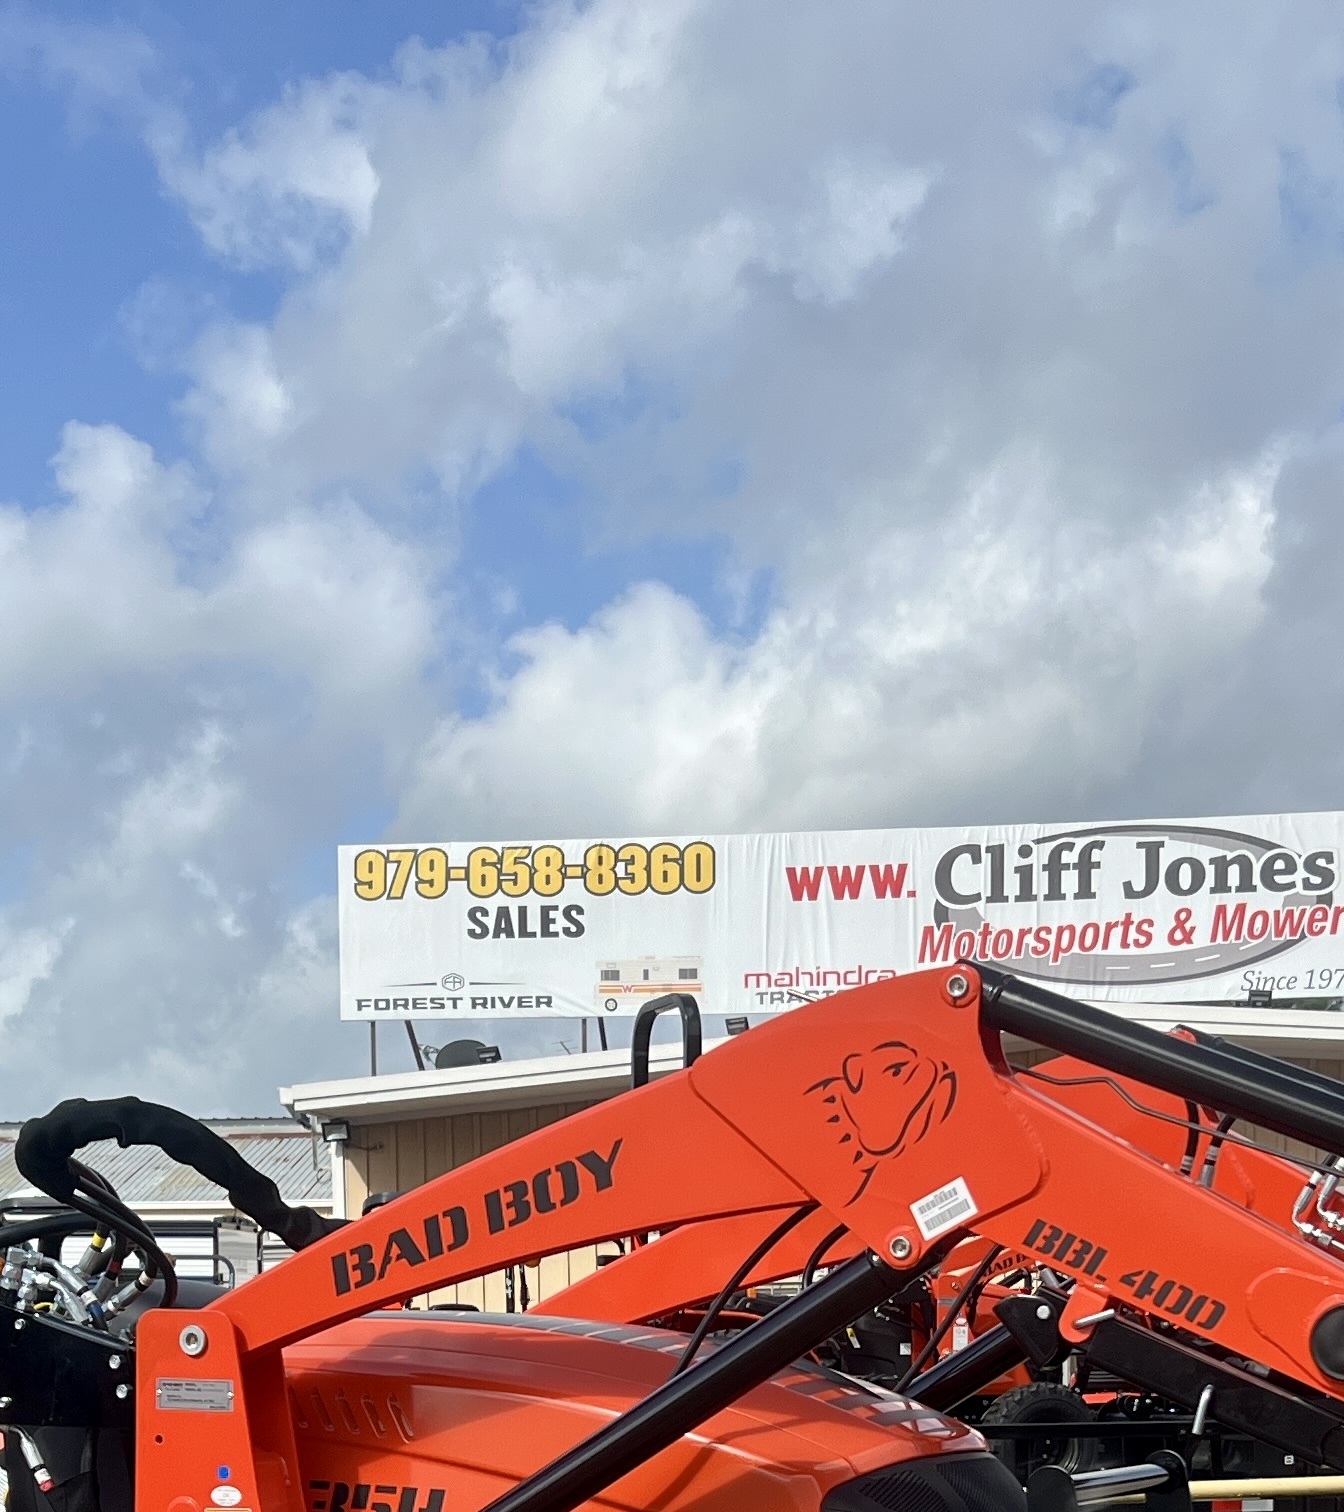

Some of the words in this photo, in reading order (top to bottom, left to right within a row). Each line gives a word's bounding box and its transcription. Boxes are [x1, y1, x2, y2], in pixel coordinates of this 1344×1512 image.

[354, 841, 716, 901] 979-658-8360
[786, 863, 916, 901] www.
[935, 840, 1107, 906] Cliff
[1122, 841, 1336, 900] Jones
[467, 905, 586, 940] SALES
[917, 912, 1155, 964] Motorsports
[1167, 908, 1196, 946] &
[356, 996, 463, 1012] FOREST
[471, 995, 553, 1010] RIVER
[744, 965, 897, 988] mahindra
[1241, 970, 1297, 992] Since
[330, 1204, 471, 1297] BAD
[483, 1138, 623, 1236] BOY
[1022, 1218, 1109, 1285] BBL
[1118, 1267, 1226, 1331] 400
